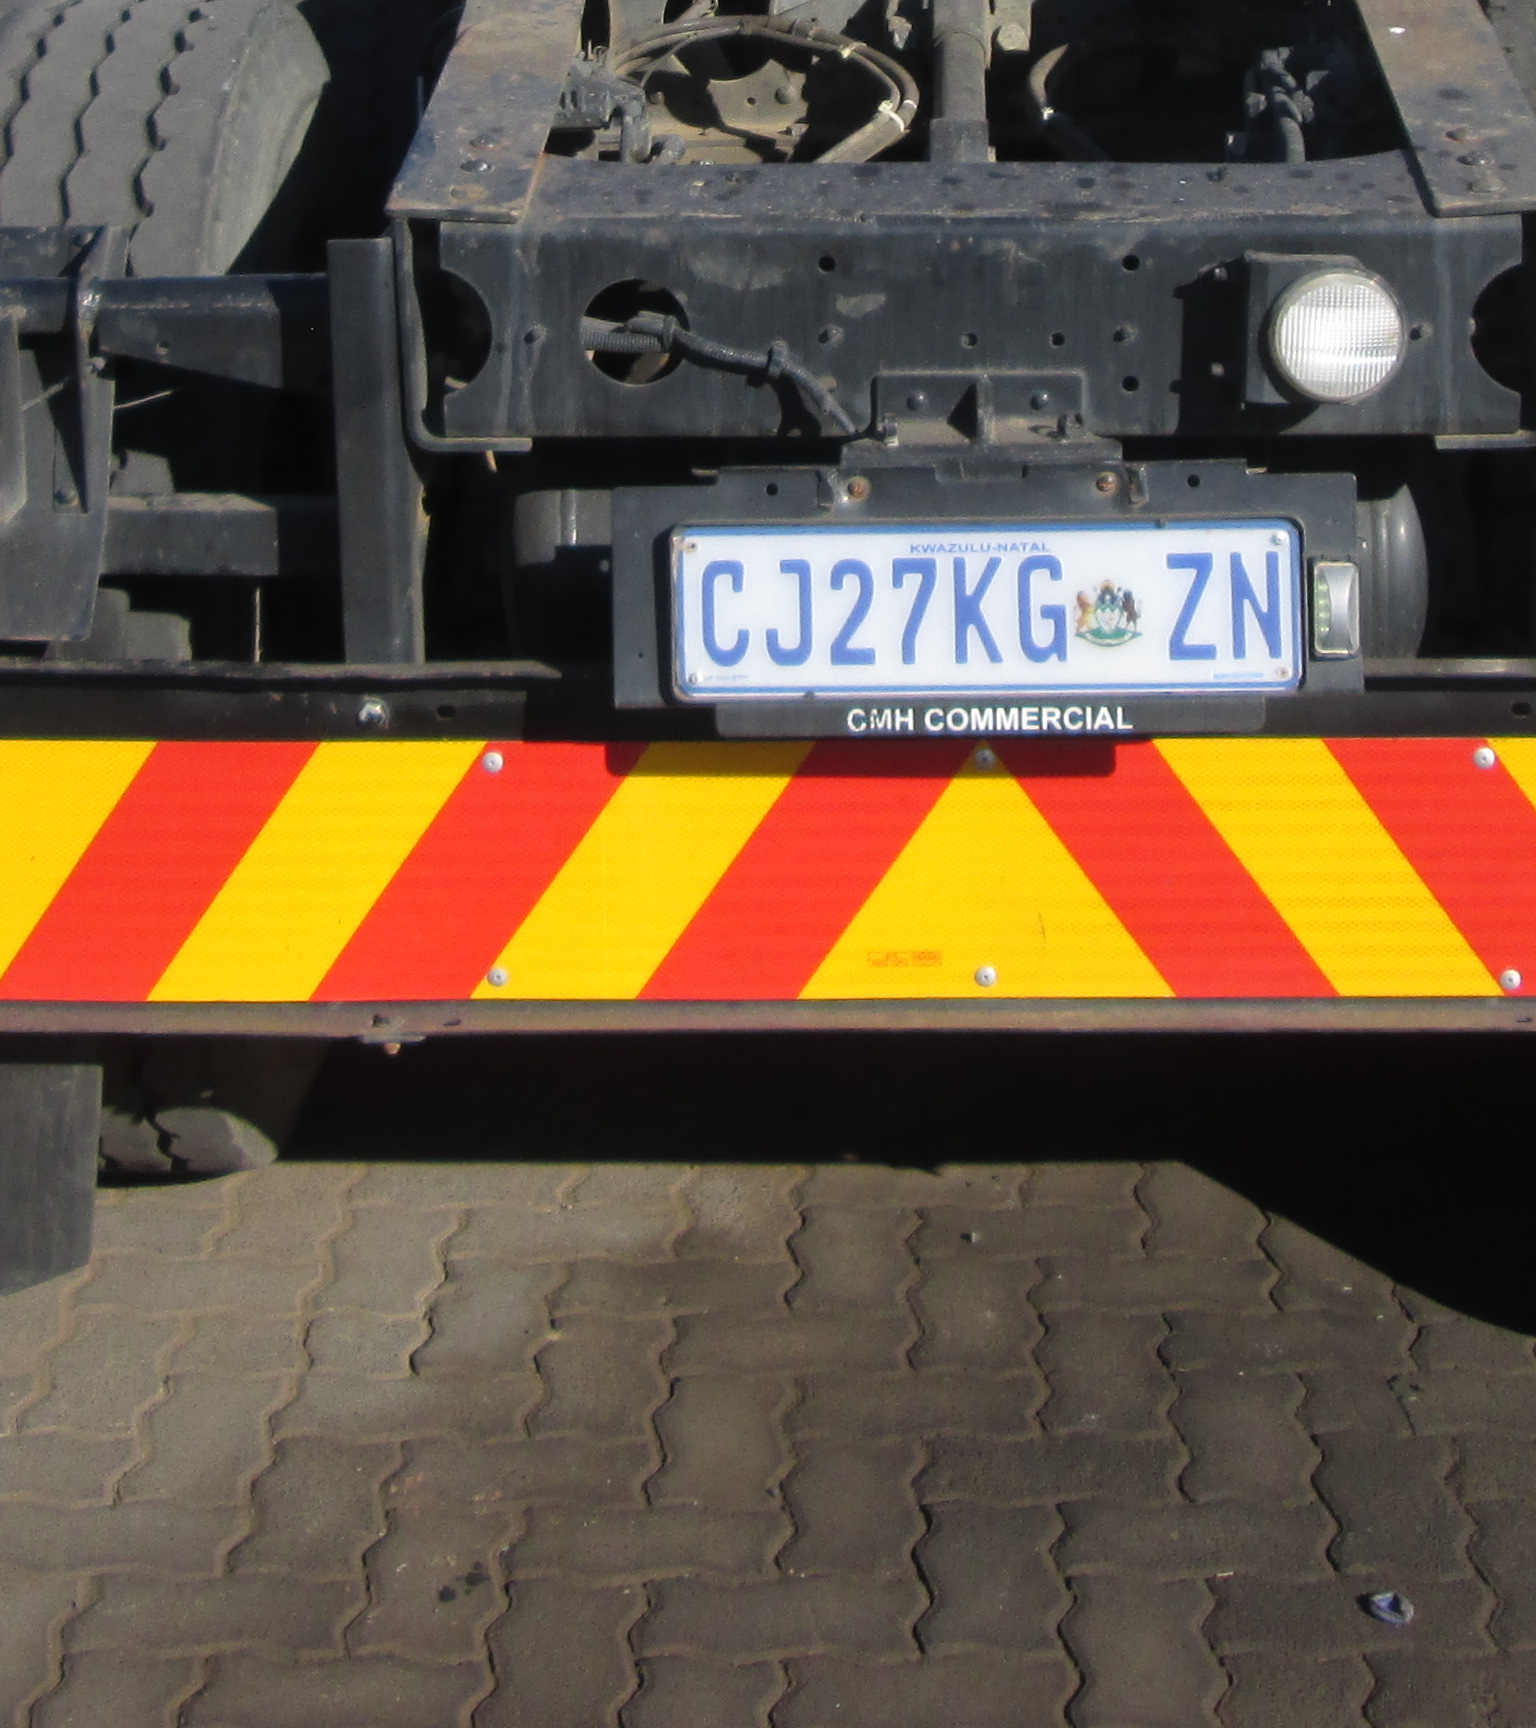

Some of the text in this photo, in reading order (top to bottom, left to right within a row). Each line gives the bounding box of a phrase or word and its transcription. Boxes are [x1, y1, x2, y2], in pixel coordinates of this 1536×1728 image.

[909, 541, 1051, 554] KWAZULU-NATAL
[700, 551, 1283, 667] CJ27KG ZN
[846, 706, 1134, 733] CMH COMMERCIAL
